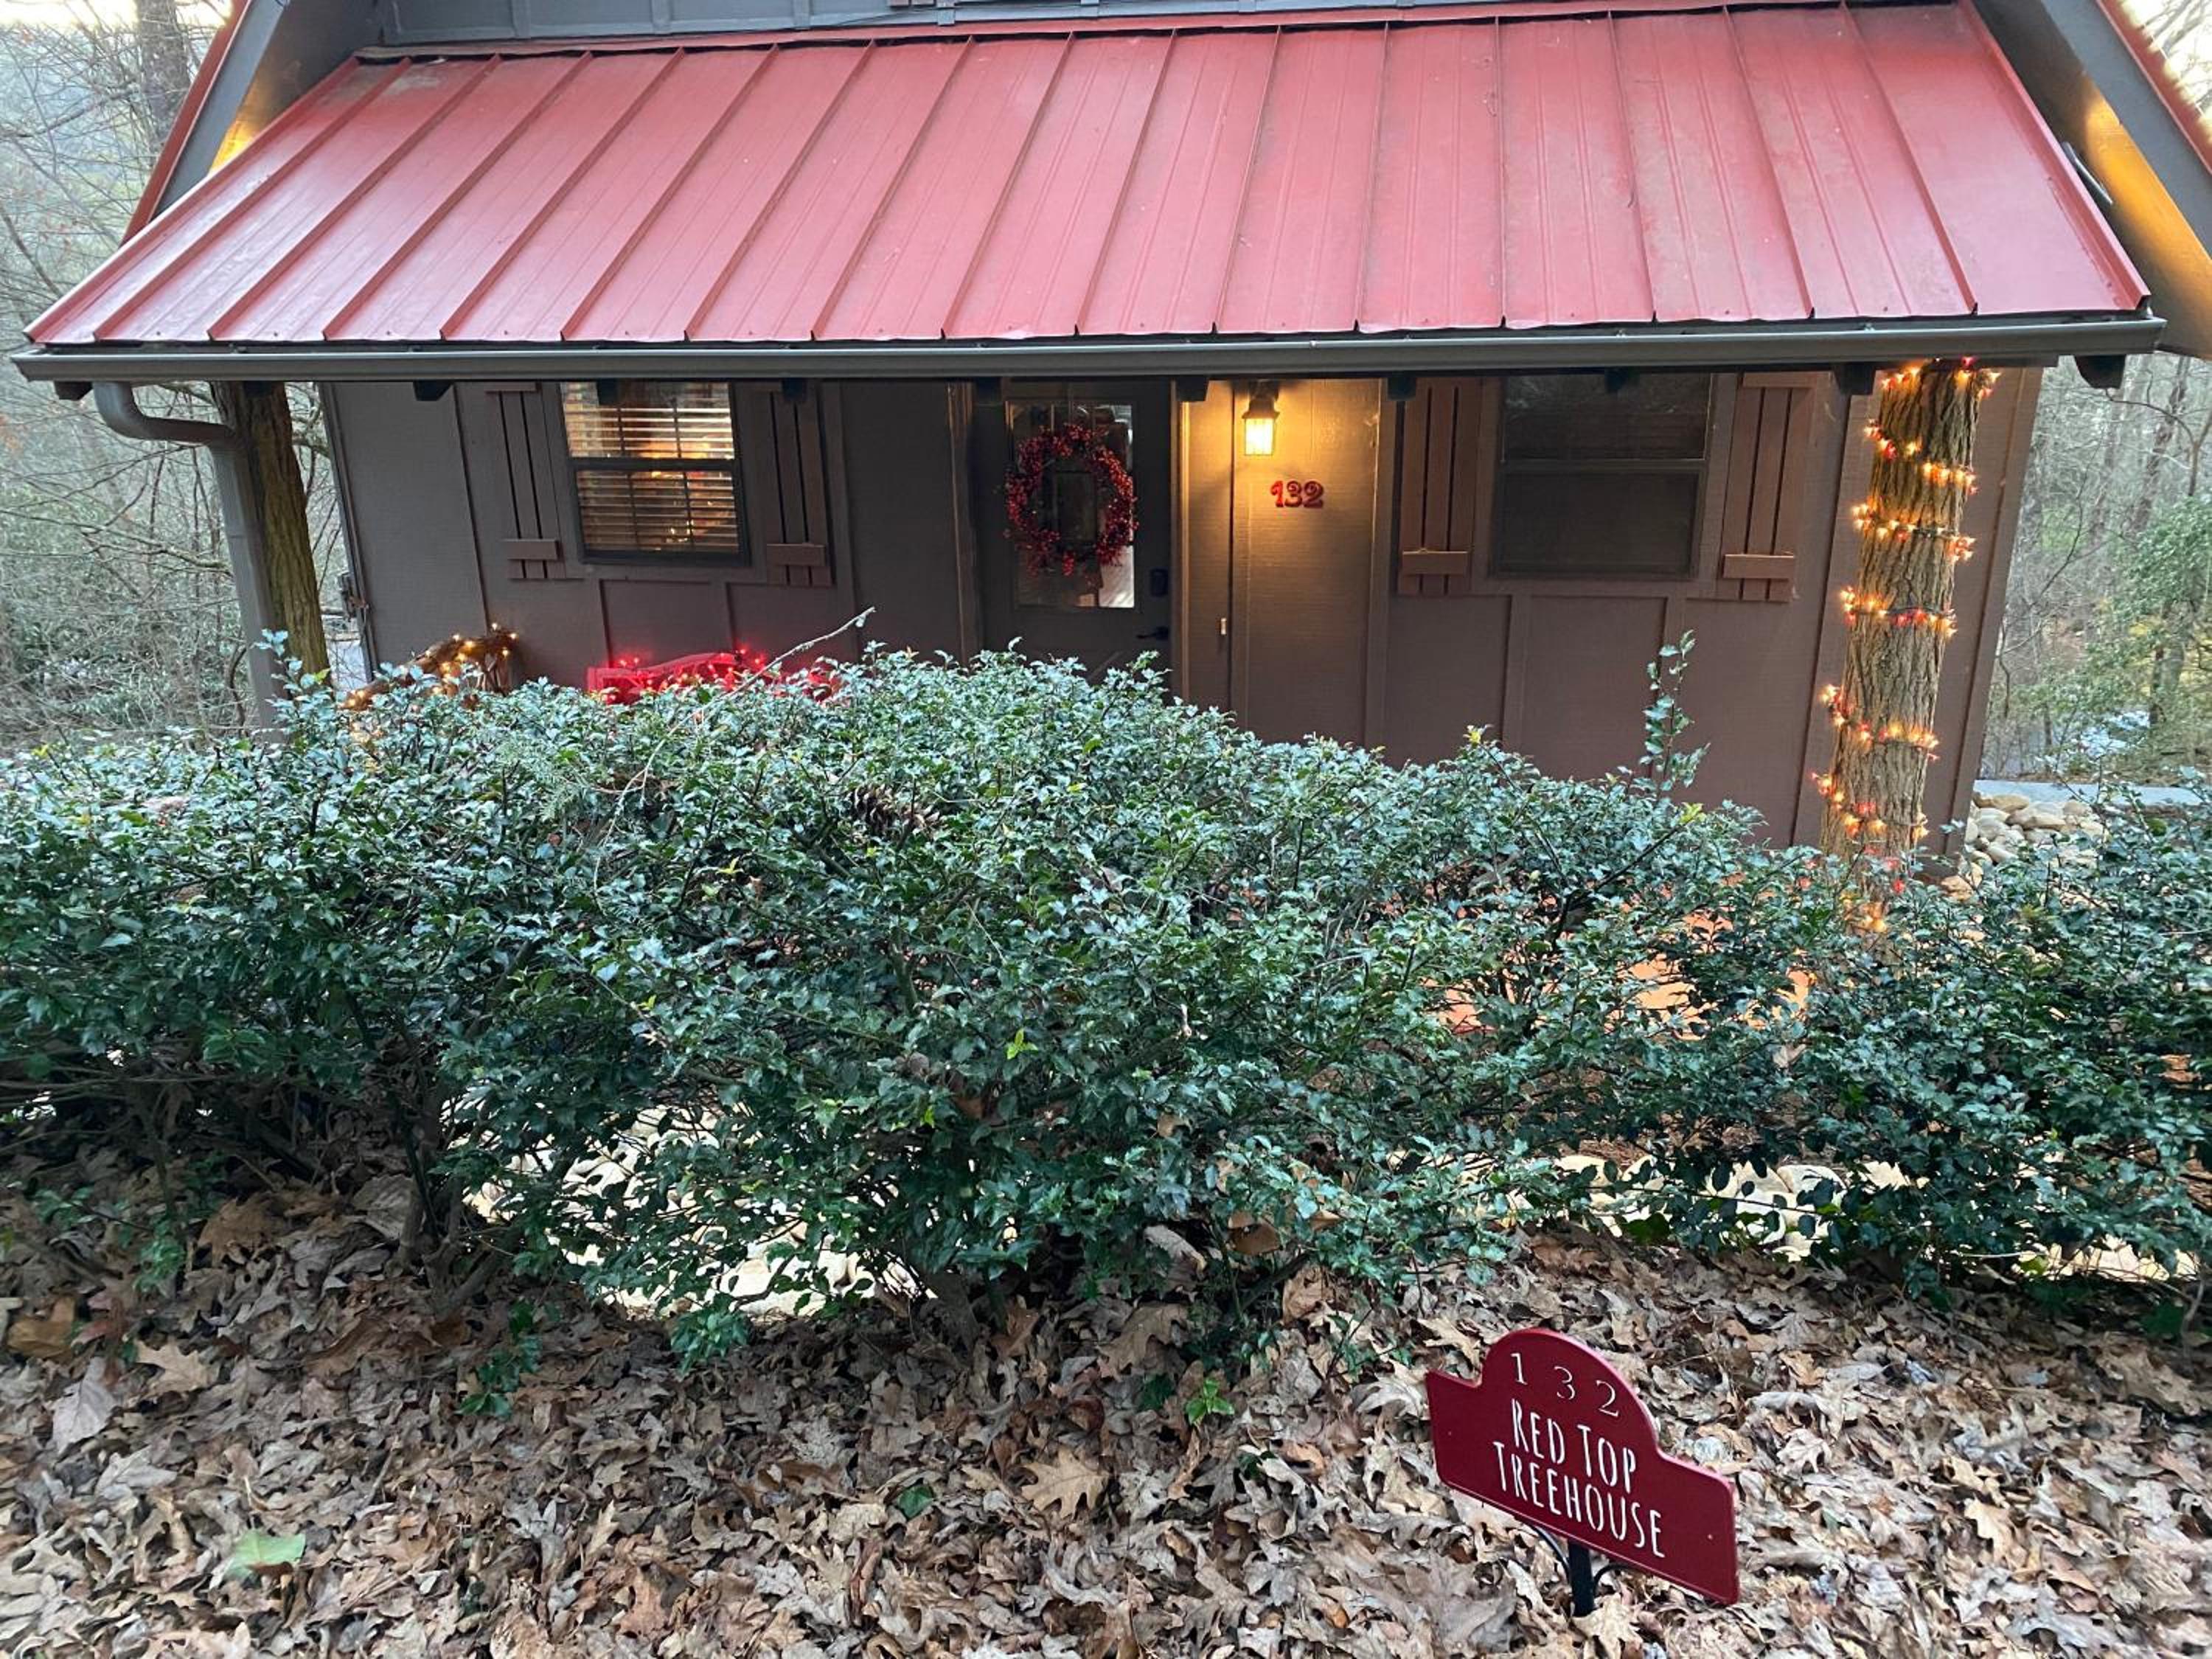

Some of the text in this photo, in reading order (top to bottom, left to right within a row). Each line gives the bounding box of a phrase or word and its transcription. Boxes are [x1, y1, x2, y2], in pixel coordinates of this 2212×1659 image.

[1270, 480, 1324, 508] 132
[1512, 1398, 1636, 1494] RED TOP
[1493, 1441, 1665, 1558] TREEHOUSE
